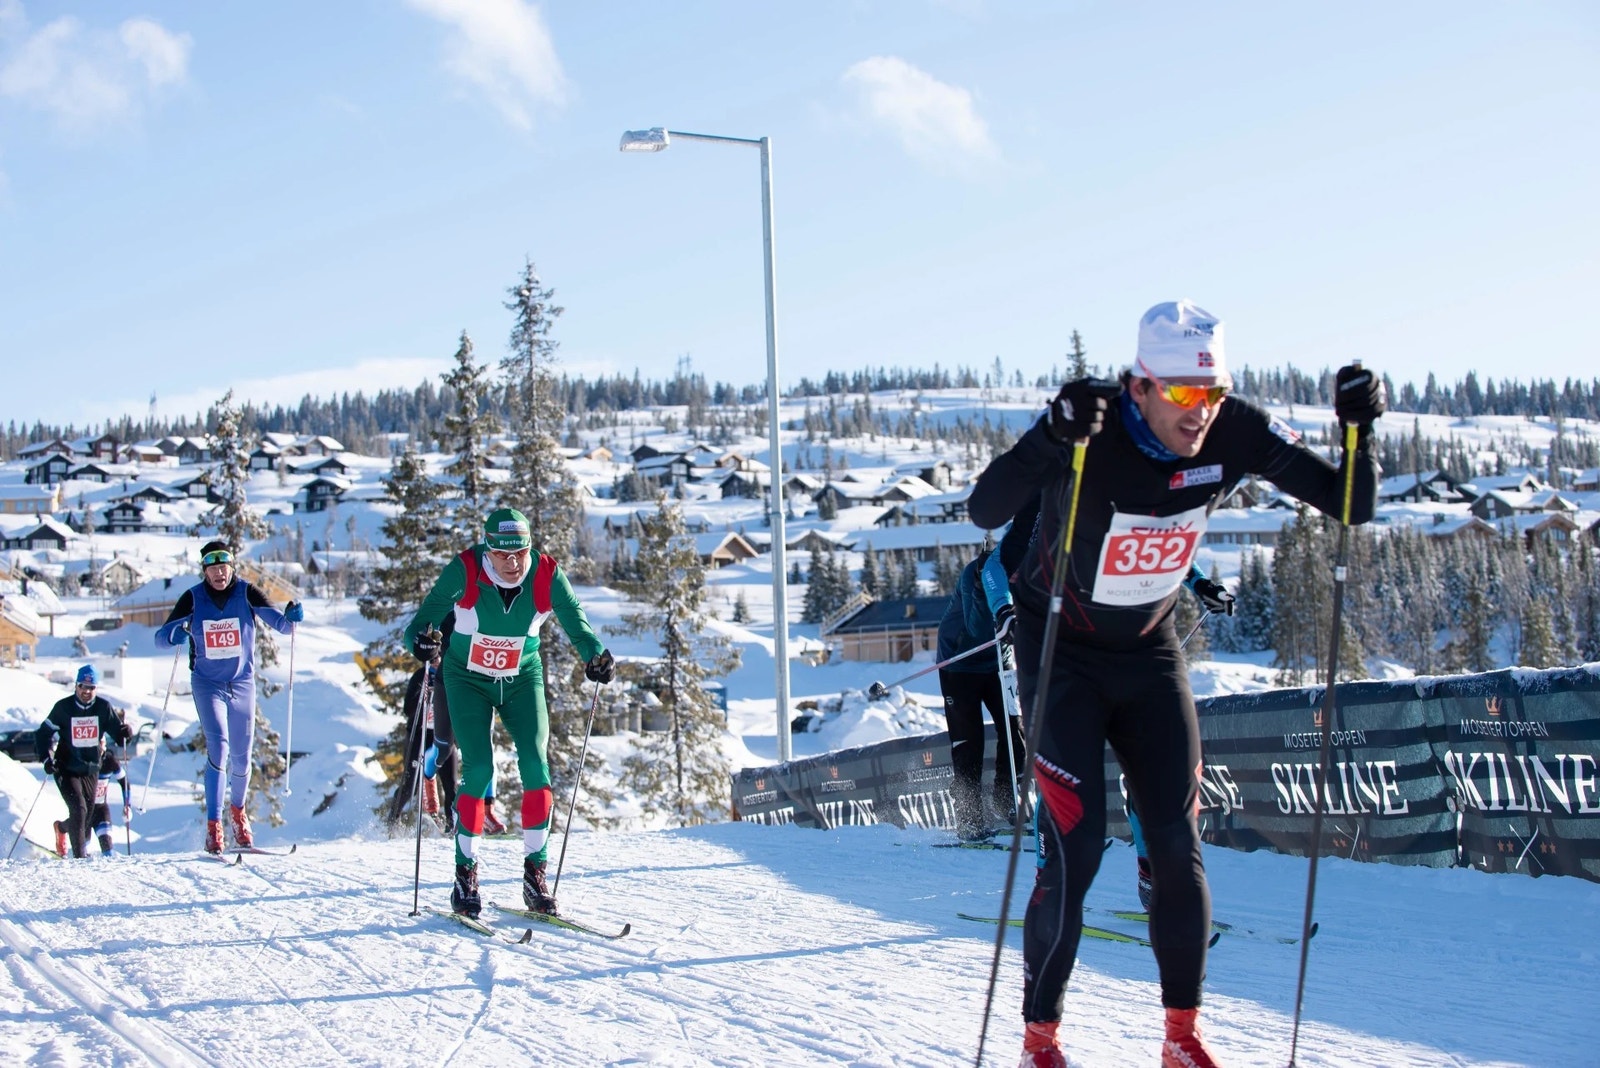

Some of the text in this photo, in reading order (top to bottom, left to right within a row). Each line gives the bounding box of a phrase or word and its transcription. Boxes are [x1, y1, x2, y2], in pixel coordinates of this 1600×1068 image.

[1115, 537, 1187, 572] 352
[211, 632, 236, 647] 149
[483, 649, 508, 669] 96
[76, 727, 95, 739] 347
[1461, 718, 1549, 737] MOSETERTOPPEN
[1284, 729, 1367, 748] MOSETEOPPEN
[1444, 750, 1600, 814] SKILINE
